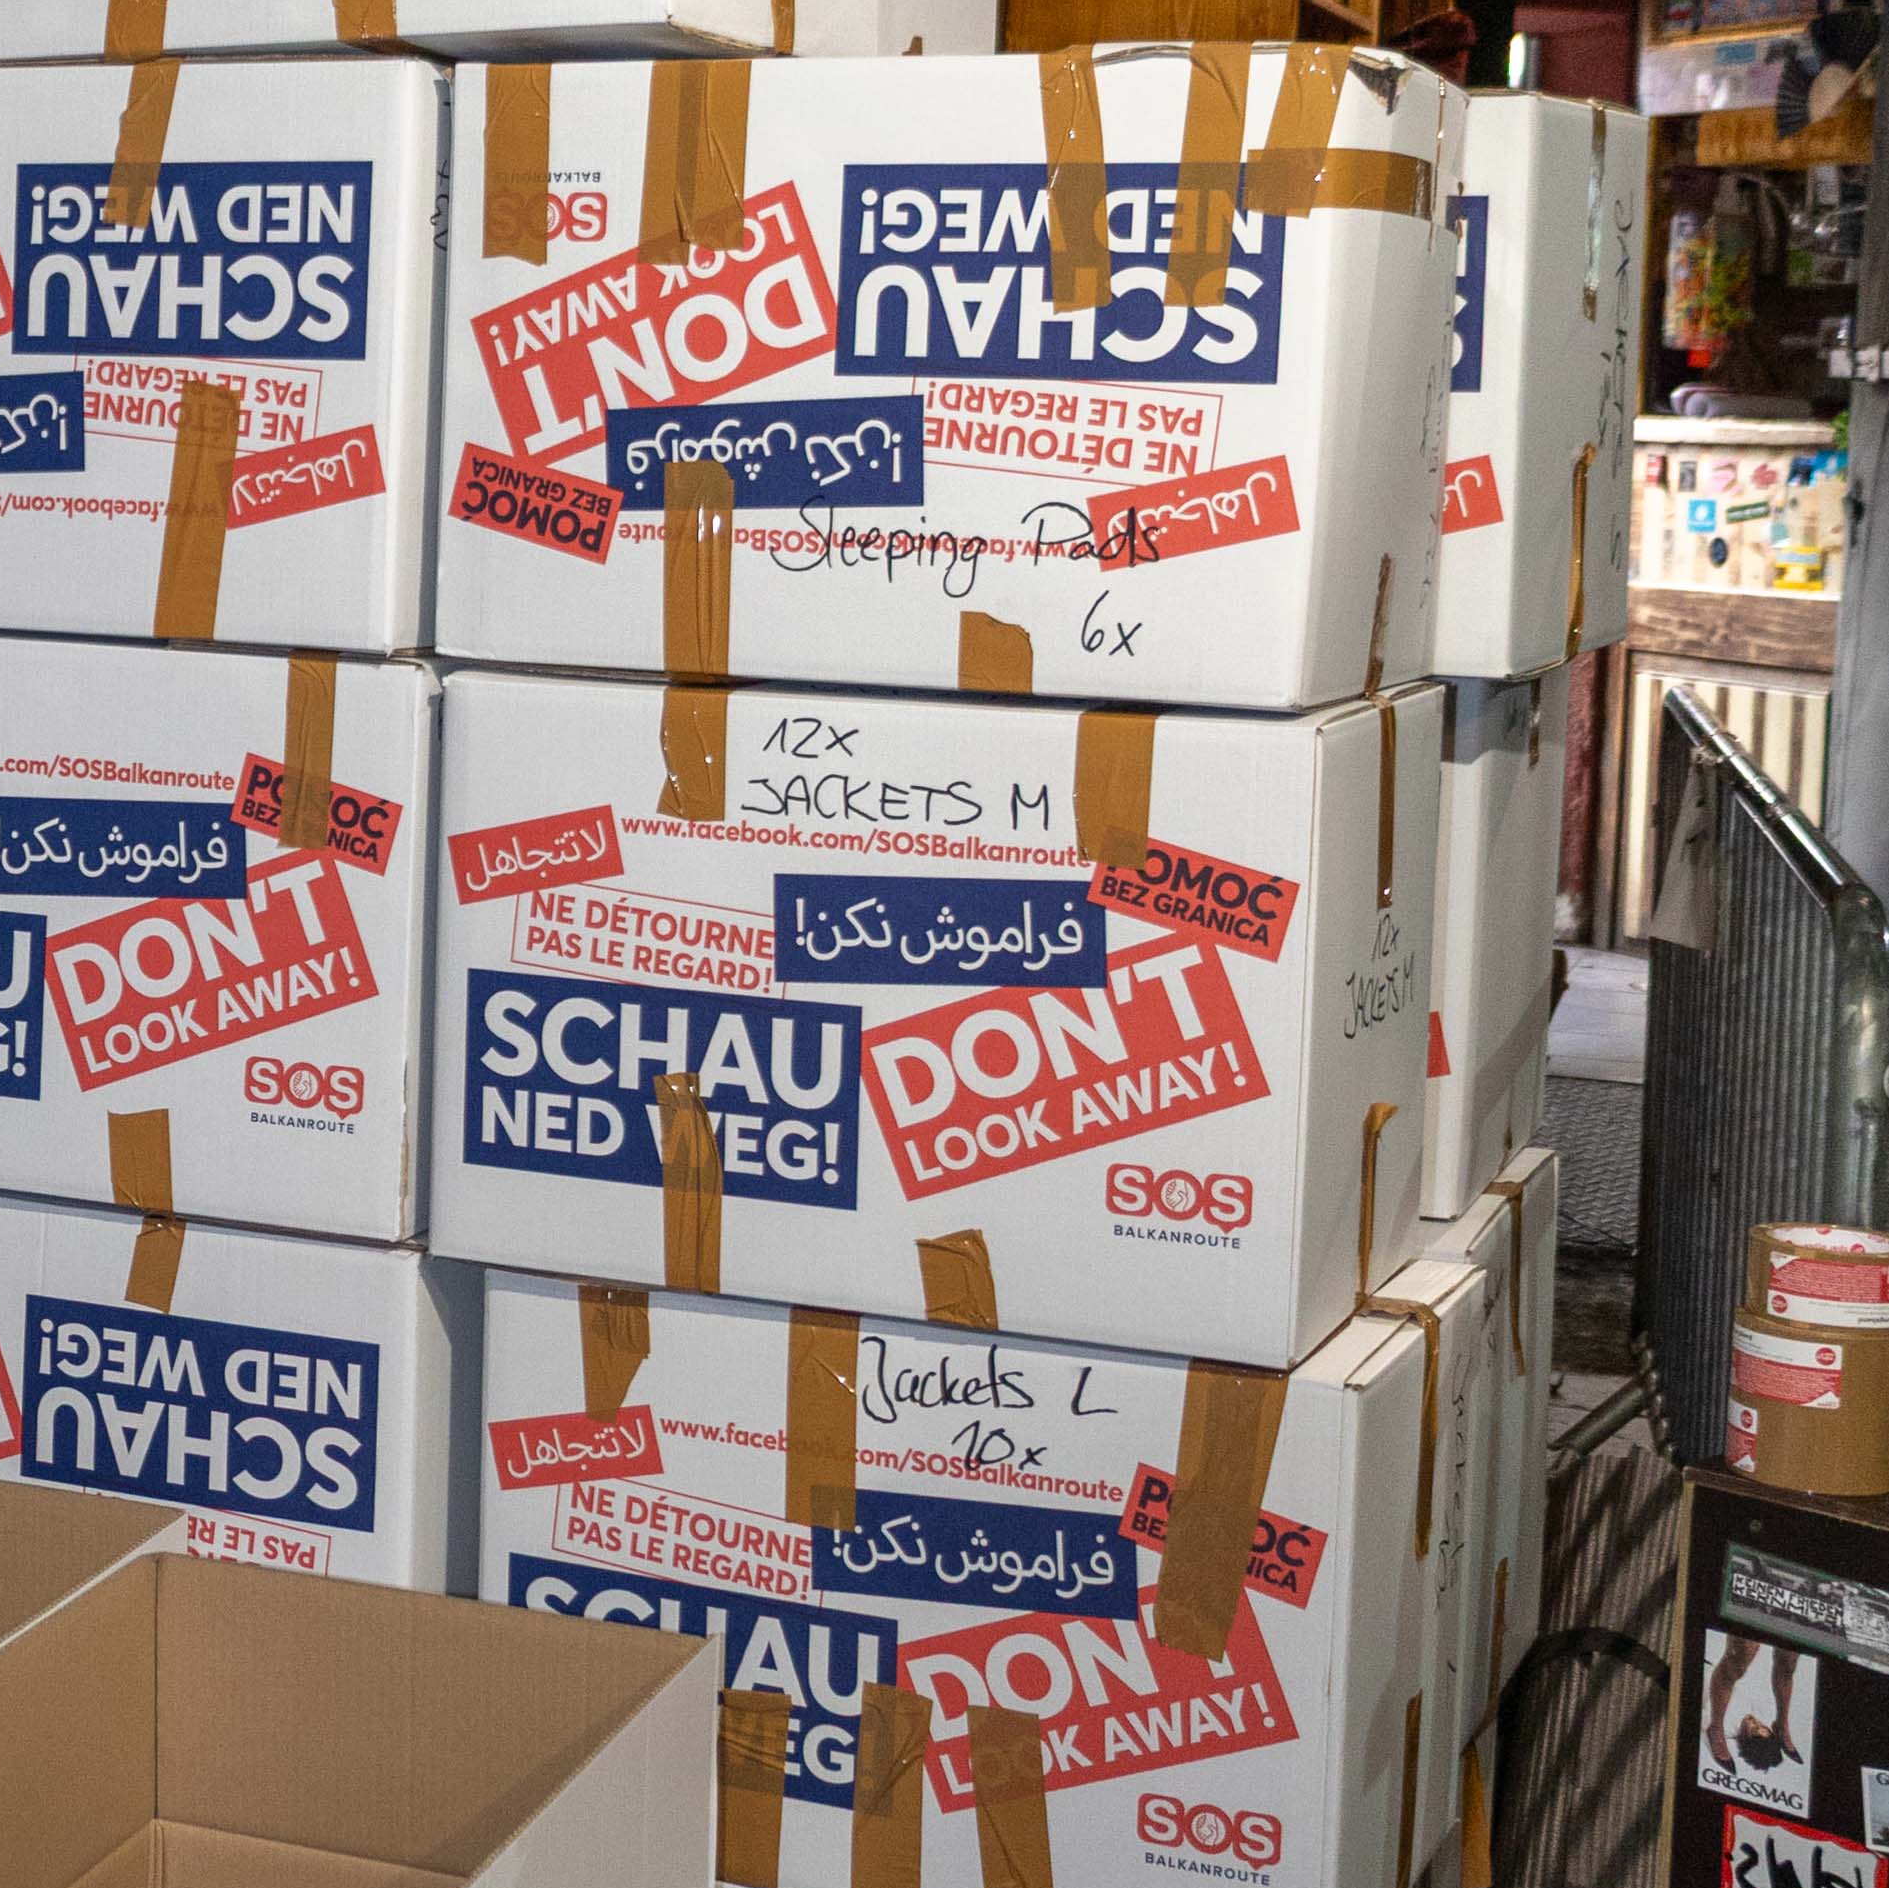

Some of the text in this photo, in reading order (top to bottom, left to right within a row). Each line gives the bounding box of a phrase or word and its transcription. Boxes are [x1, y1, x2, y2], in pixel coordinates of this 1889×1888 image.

[26, 250, 354, 343] SCHAU
[925, 381, 1204, 435] PAS LE REGARD!
[460, 478, 605, 553] POMOĆ
[771, 497, 992, 598] Sleeping
[740, 772, 1049, 832] JACKETS M
[1099, 874, 1266, 948] BEZ GRANICA
[249, 1060, 355, 1116] SOS
[481, 987, 845, 1115] SCHAU
[248, 1112, 351, 1138] BALKANROUTE
[905, 1043, 1247, 1182] LOOK AWAY!
[40, 1318, 360, 1422] NED WEG!
[36, 1378, 361, 1516] SCHAU
[570, 1484, 616, 1518] NE
[566, 1517, 811, 1601] PAS LE REGARD!
